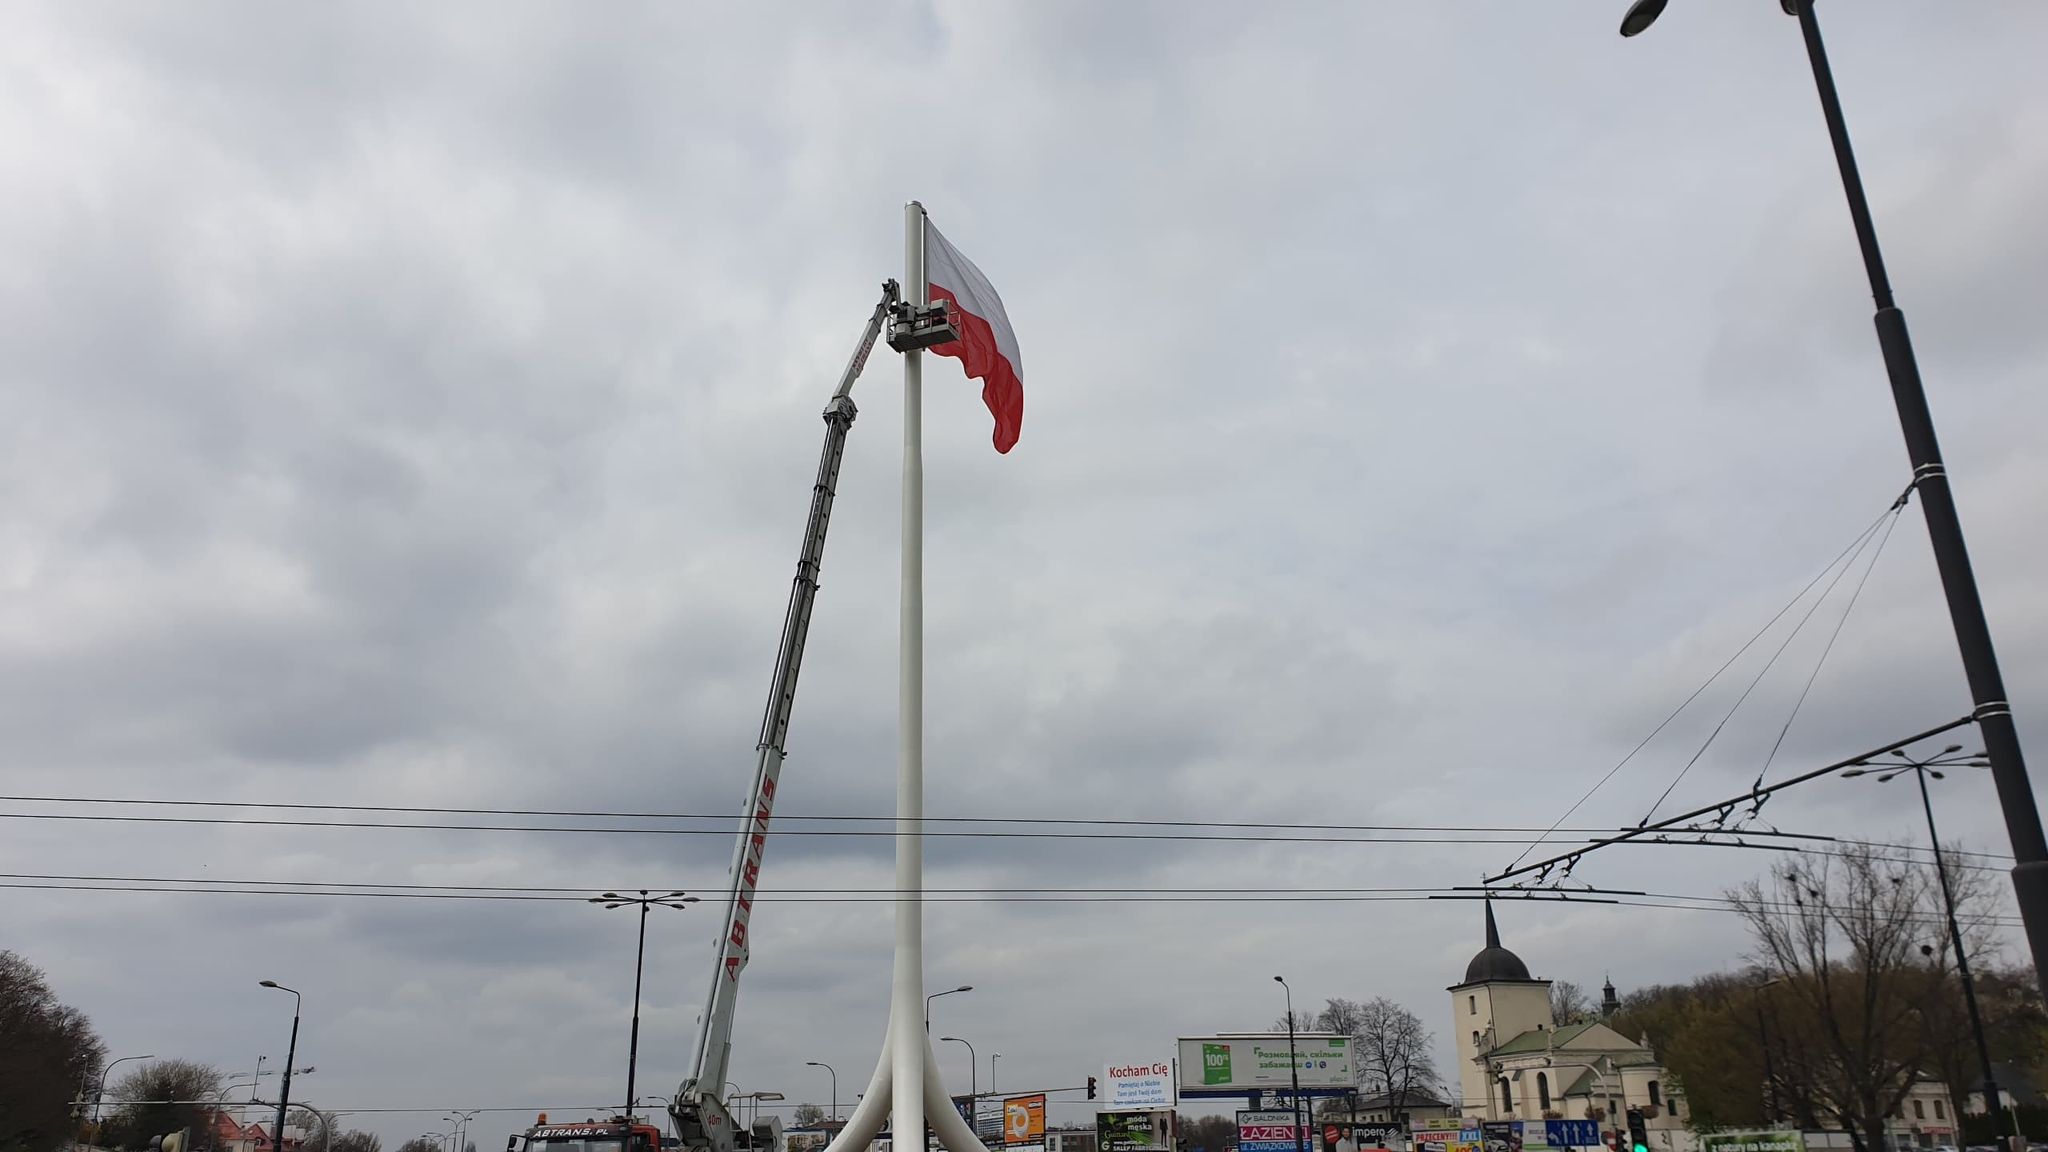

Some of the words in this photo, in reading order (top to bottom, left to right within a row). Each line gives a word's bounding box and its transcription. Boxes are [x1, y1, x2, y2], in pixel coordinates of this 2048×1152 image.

[725, 774, 776, 982] ABTRANS
[1205, 1054, 1223, 1066] 100
[1109, 1065, 1150, 1078] Kocham
[1152, 1063, 1168, 1077] Cię
[1126, 1115, 1147, 1123] moda
[1352, 1127, 1385, 1138] impero
